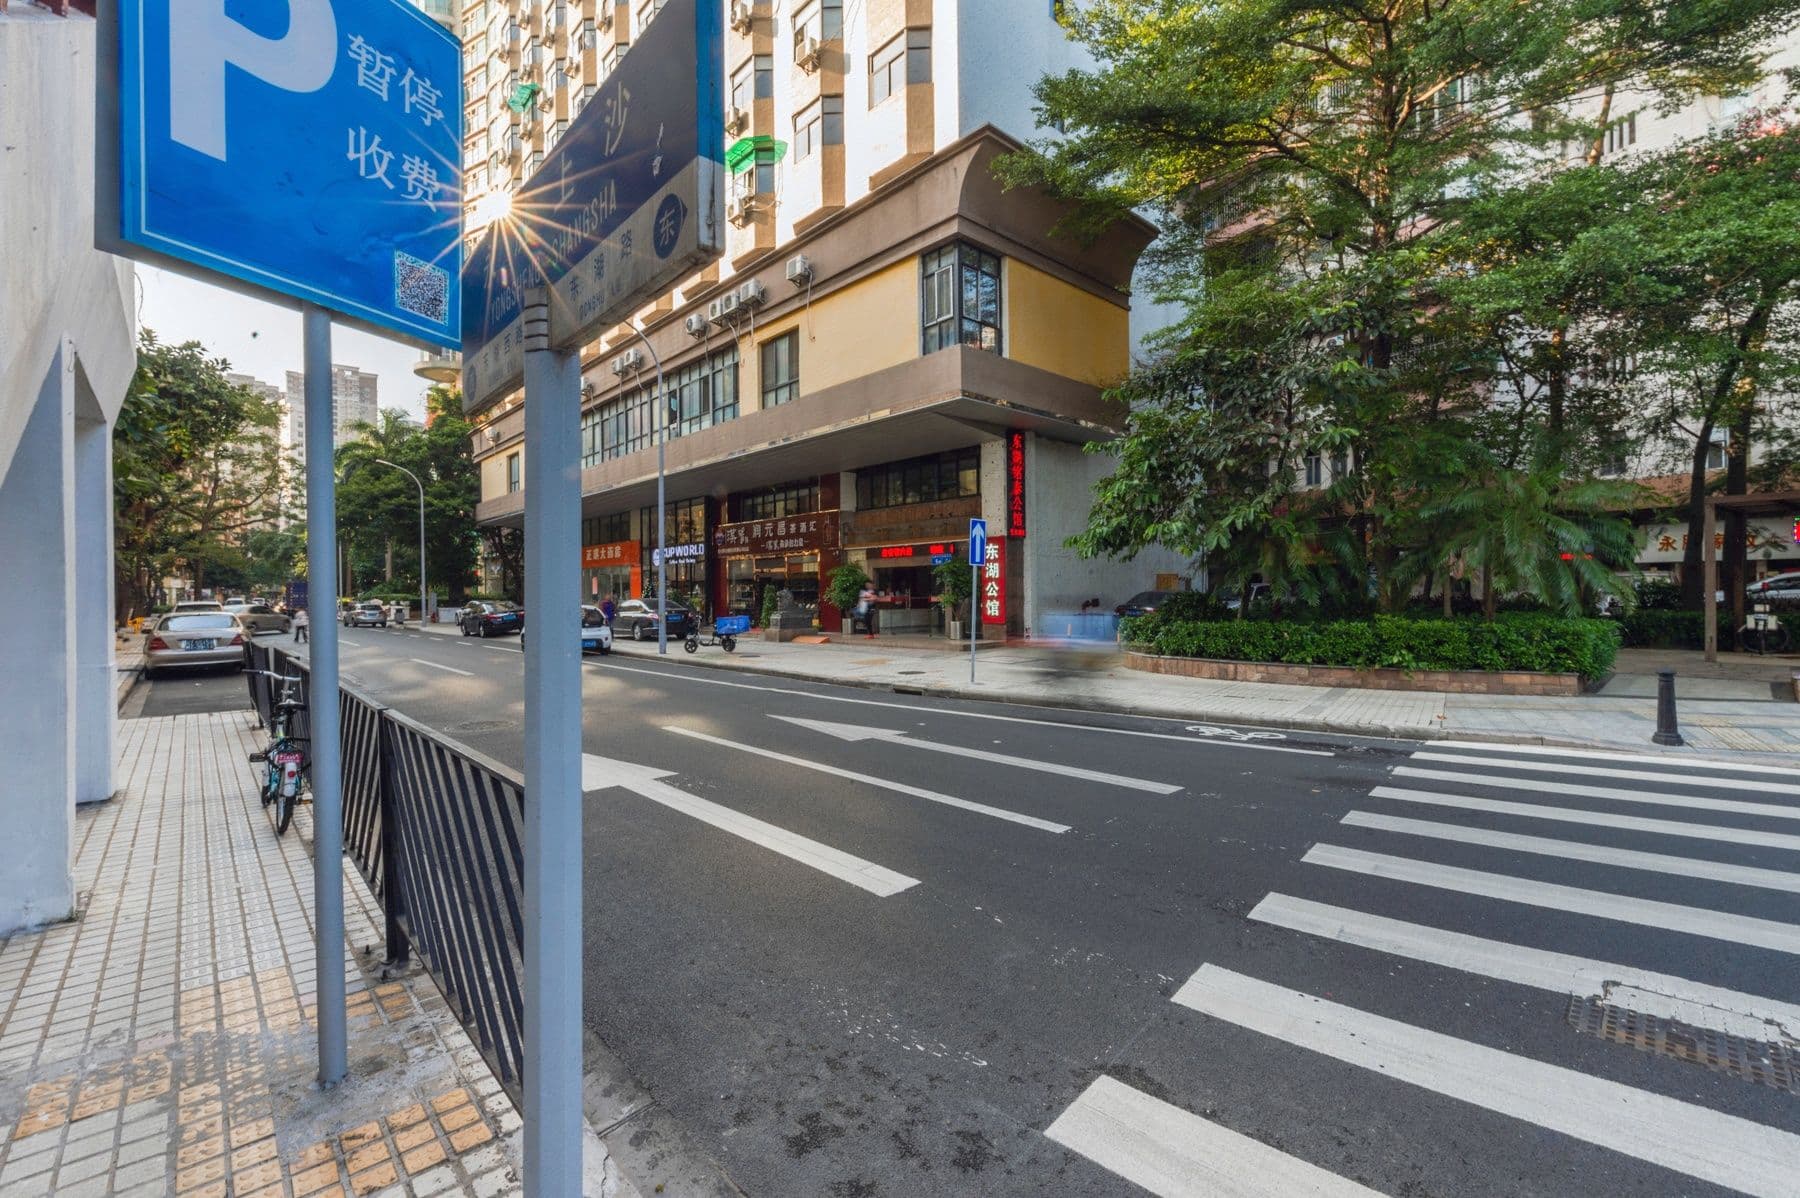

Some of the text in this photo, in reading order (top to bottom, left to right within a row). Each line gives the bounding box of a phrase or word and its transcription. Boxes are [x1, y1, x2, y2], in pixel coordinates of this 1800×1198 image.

[170, 0, 338, 162] P
[347, 33, 444, 127] 暂停
[346, 126, 440, 213] 收费
[659, 208, 676, 247] 东
[985, 544, 999, 617] 东湖公馆
